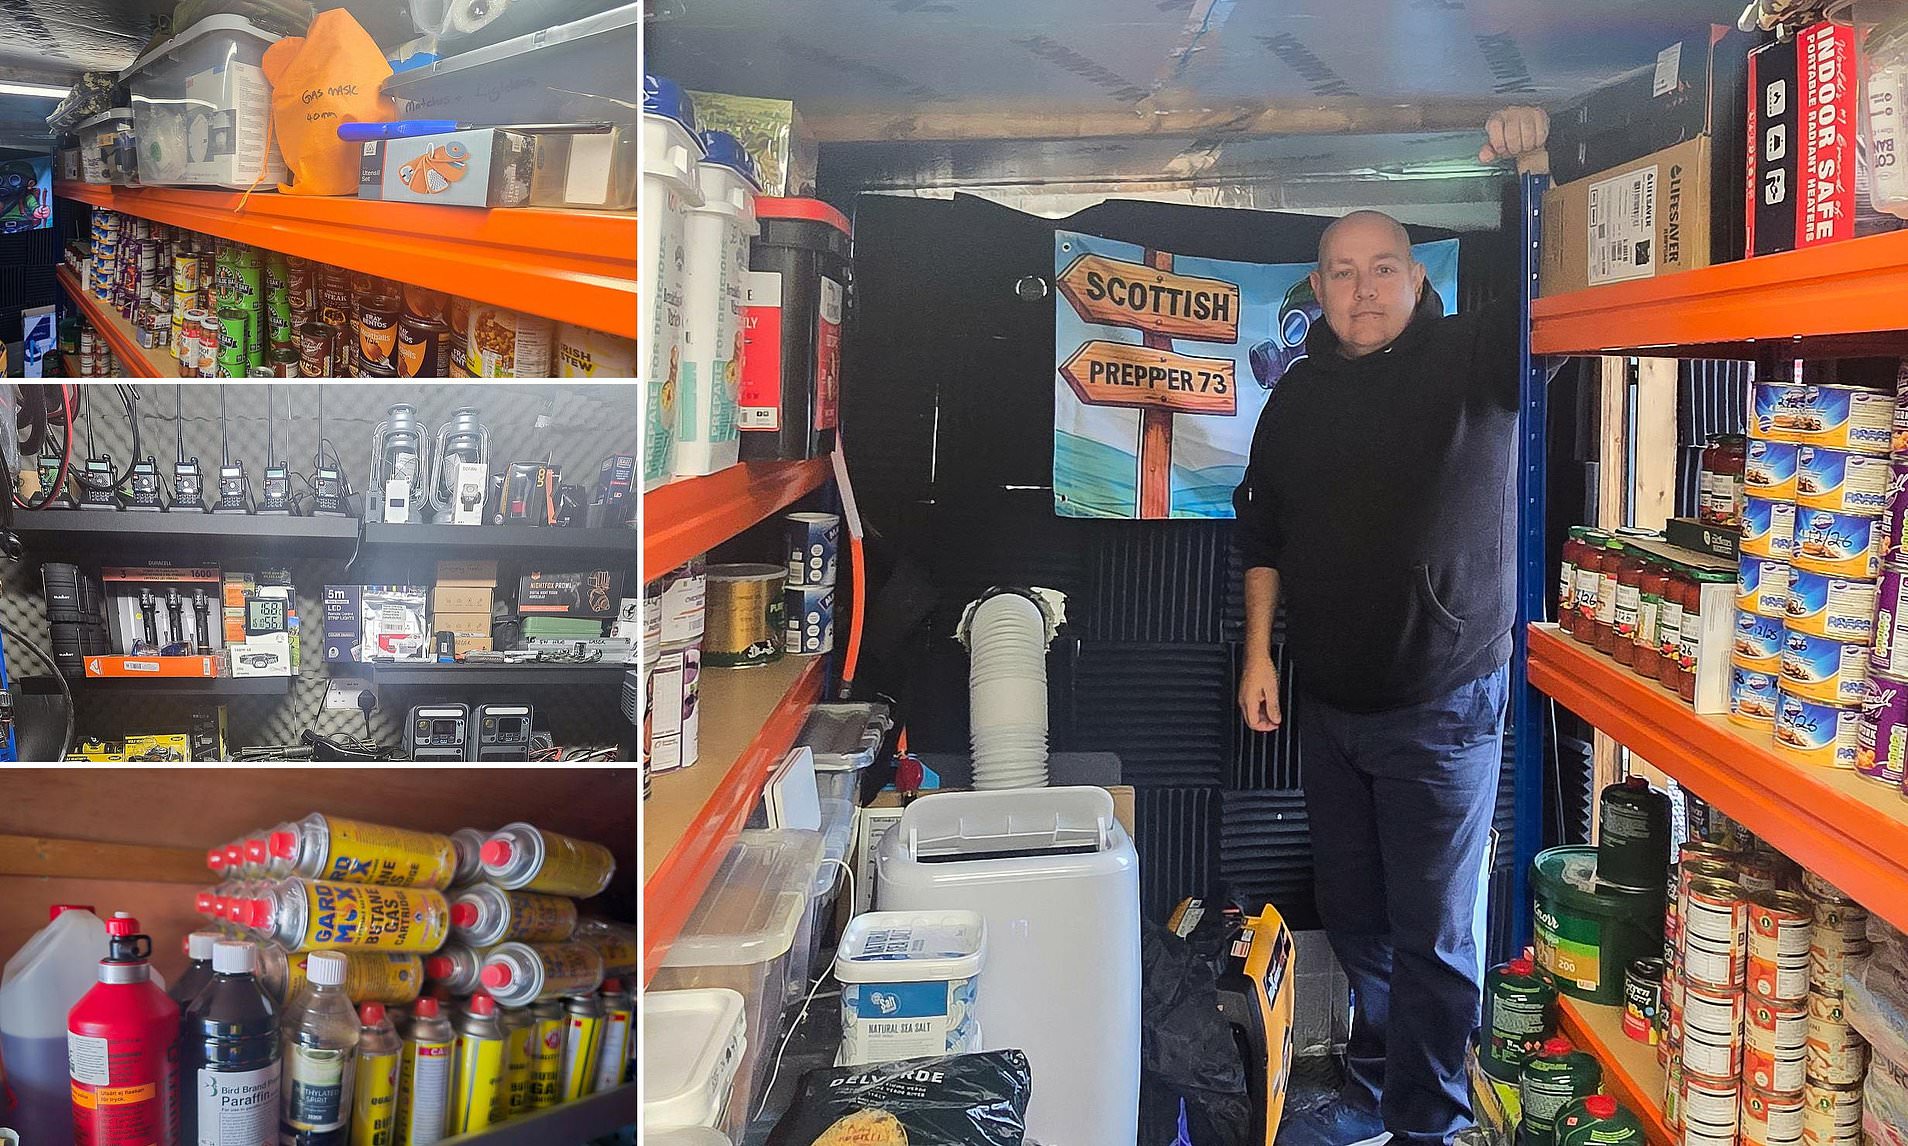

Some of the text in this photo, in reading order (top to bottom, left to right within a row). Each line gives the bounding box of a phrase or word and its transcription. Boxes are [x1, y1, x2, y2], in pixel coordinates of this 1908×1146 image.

[1834, 39, 1847, 103] World's
[302, 87, 323, 104] GAS
[1805, 34, 1817, 242] PORTABLE RADIANT HEATERS
[1815, 26, 1836, 240] INDOOR SAFE
[1645, 181, 1654, 228] LIFESAVER
[1668, 178, 1682, 263] LIFESAVER
[1086, 271, 1230, 322] SCOTTISH
[453, 349, 467, 359] FRA
[560, 352, 593, 372] STEW
[1089, 360, 1228, 394] PREPPER 73
[711, 362, 723, 437] PREPARE
[644, 383, 659, 474] PREPARE
[120, 570, 127, 579] 3
[190, 570, 211, 578] 1600
[328, 589, 345, 599] 5m
[315, 884, 336, 943] GARD
[364, 887, 385, 945] BUTANE
[383, 899, 400, 934] GAS
[1535, 899, 1560, 930] Knorr
[1558, 959, 1576, 973] 200
[868, 1022, 932, 1034] NATURAL SEA SALT
[221, 1082, 267, 1095] Bird Brand
[828, 1069, 945, 1088] DELVRDE
[221, 1091, 270, 1107] Paraffin
